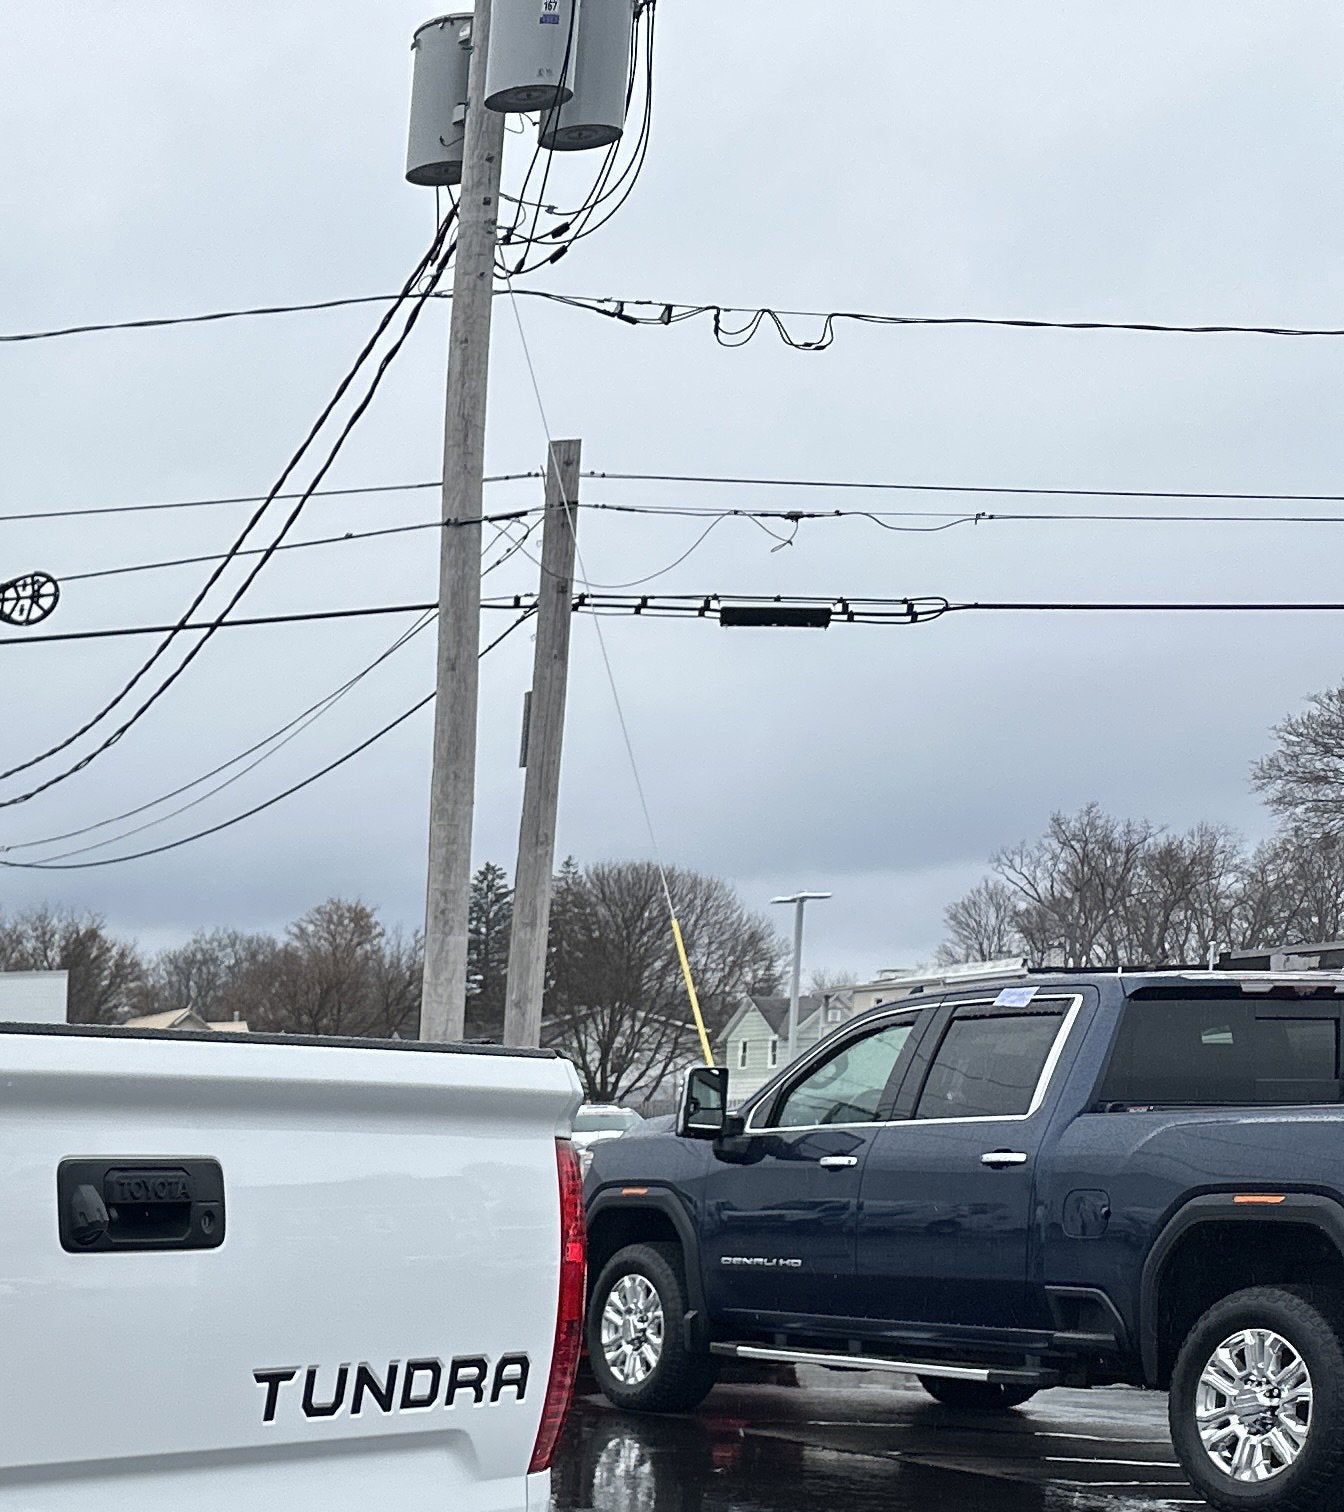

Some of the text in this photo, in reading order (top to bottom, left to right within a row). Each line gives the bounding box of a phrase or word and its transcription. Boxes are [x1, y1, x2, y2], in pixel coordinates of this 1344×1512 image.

[118, 1178, 191, 1201] TOYOTA
[720, 1256, 777, 1266] DENALI
[252, 1351, 533, 1425] TUNDRA
